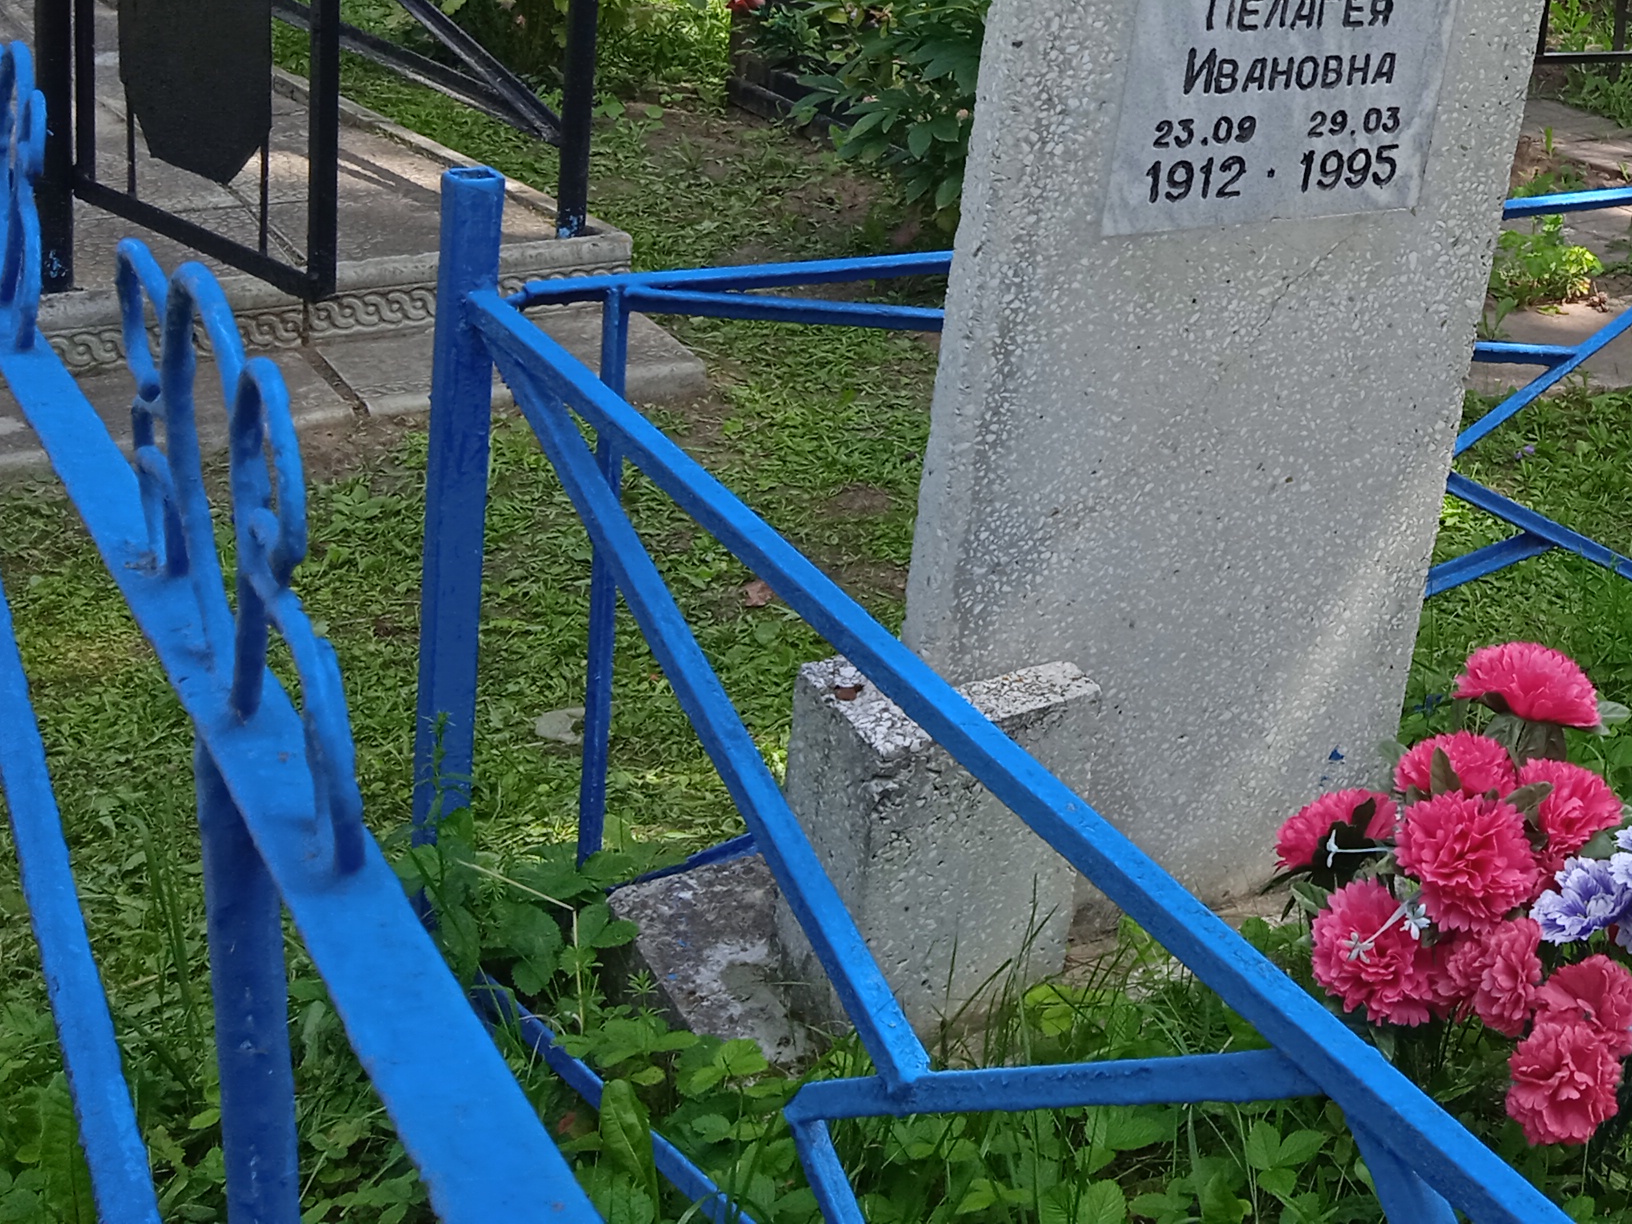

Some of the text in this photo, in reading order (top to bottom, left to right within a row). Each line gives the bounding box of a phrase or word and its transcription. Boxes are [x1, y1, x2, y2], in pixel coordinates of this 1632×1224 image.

[1182, 46, 1397, 96] ИВАНОВНА
[1152, 106, 1401, 149] 23.09 29.03
[1145, 154, 1247, 204] 1912
[1300, 142, 1400, 194] 1995
